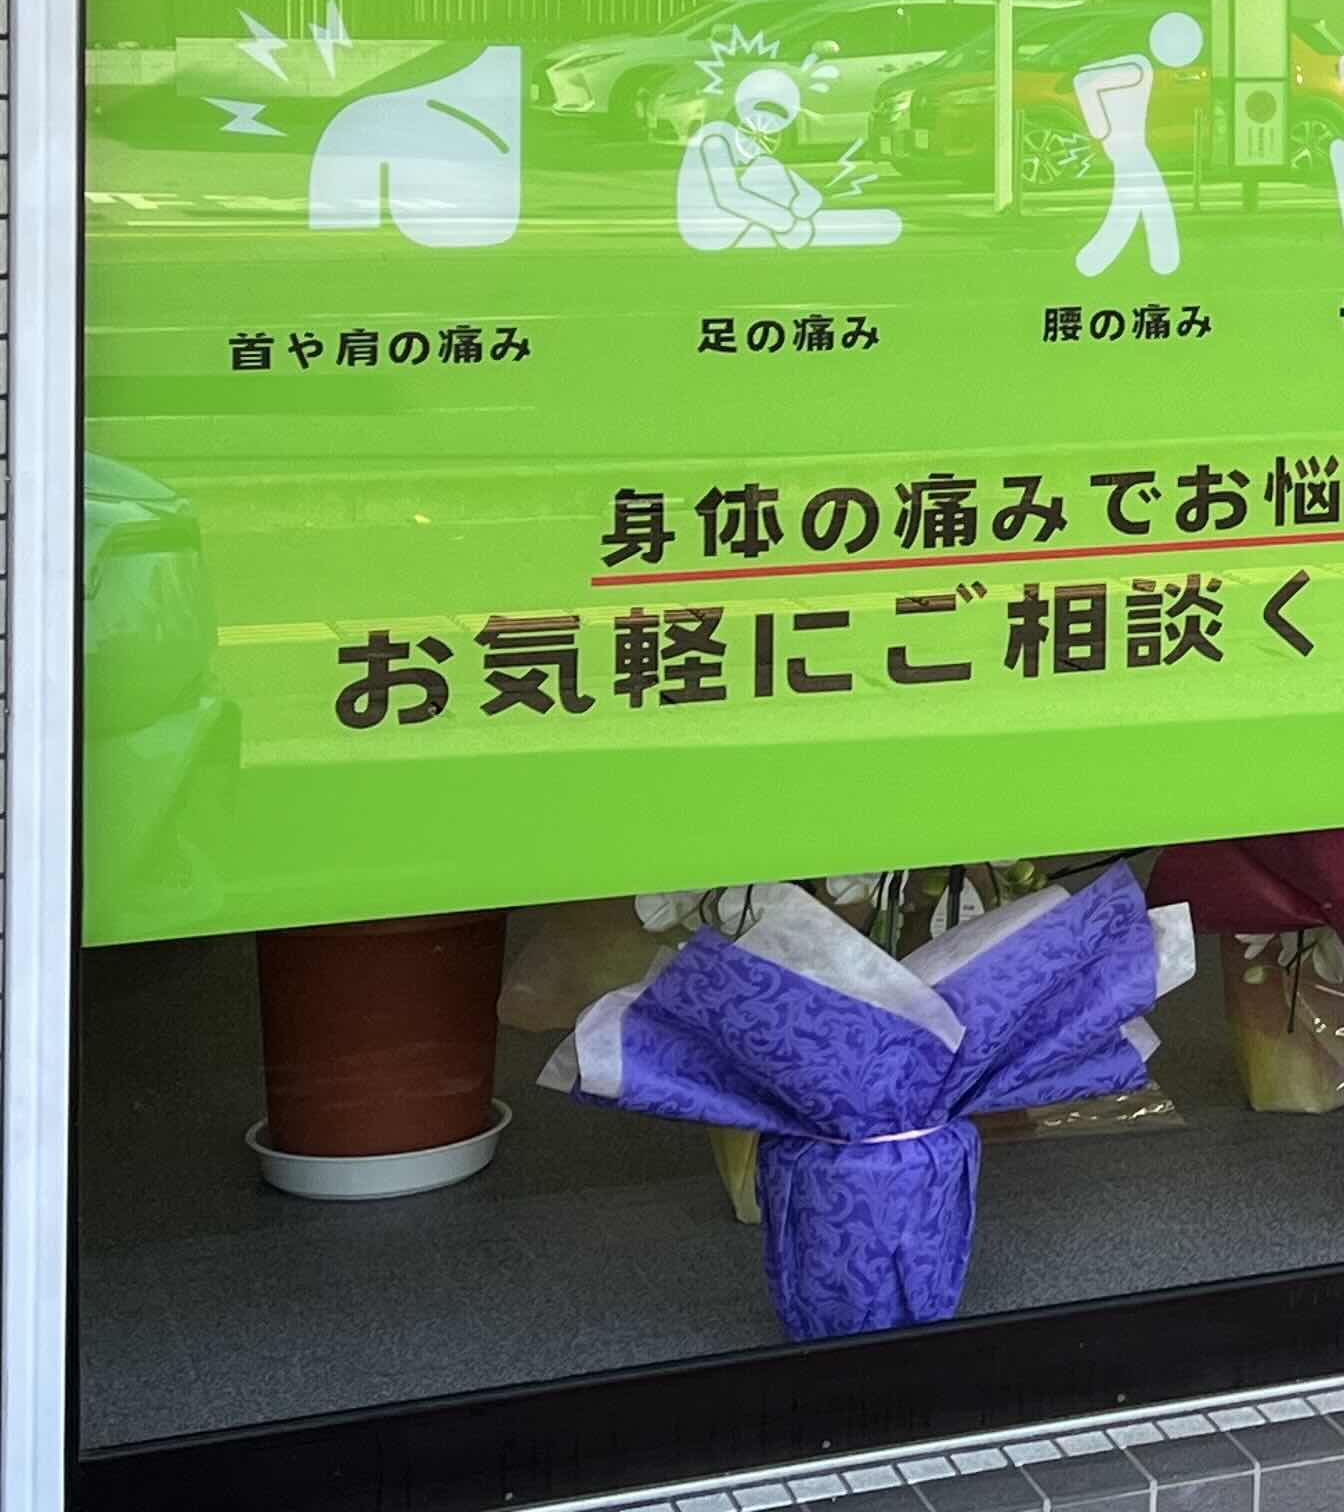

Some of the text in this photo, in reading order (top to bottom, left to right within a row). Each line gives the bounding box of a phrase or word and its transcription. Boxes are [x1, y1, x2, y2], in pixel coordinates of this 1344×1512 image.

[697, 314, 881, 355] 足の痛み
[1041, 302, 1213, 344] 腰の痛み
[228, 323, 532, 372] 首や肩の痛み
